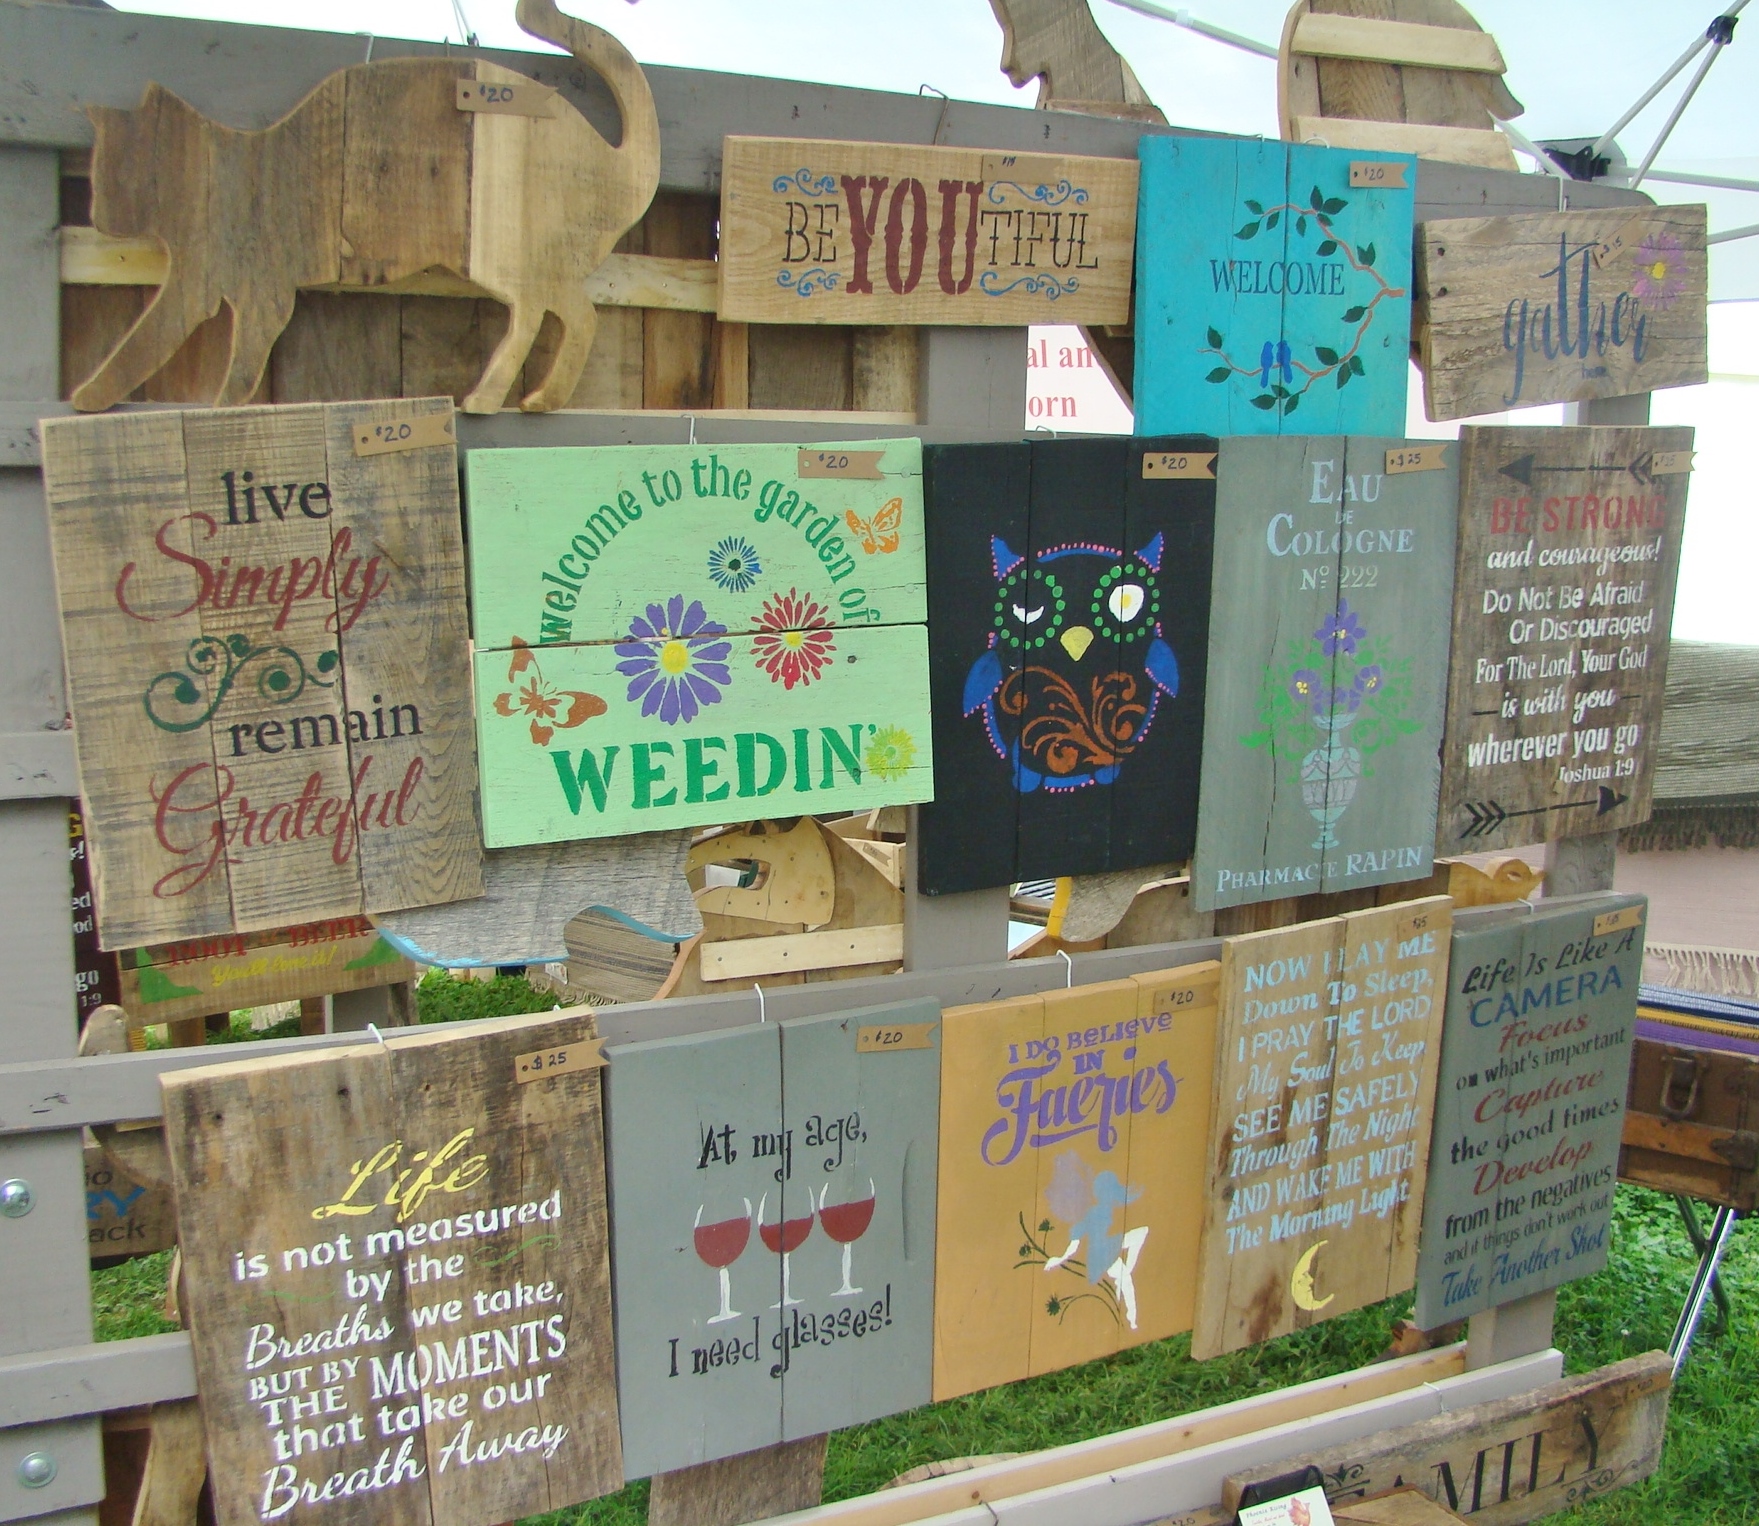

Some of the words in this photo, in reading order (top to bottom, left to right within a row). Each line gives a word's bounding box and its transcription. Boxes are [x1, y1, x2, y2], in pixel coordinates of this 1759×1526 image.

[1210, 259, 1345, 296] WELCOME
[375, 423, 412, 443] $20
[818, 453, 848, 469] $20
[1161, 456, 1187, 470] $20
[220, 470, 333, 526] live
[1490, 497, 1533, 534] BE
[1542, 493, 1667, 532] STRONG
[115, 511, 390, 634] Simply
[540, 486, 644, 644] welcome
[641, 467, 682, 508] to
[690, 454, 752, 501] the
[753, 479, 857, 585] garden
[838, 587, 881, 623] of
[1338, 565, 1379, 589] 222
[1487, 539, 1534, 569] and
[1538, 535, 1662, 577] courageous!
[1482, 589, 1511, 614] Do
[1517, 583, 1552, 613] Not
[1558, 585, 1584, 609] Be
[1589, 580, 1645, 607] Afraid
[1509, 618, 1533, 644] Or
[1539, 608, 1653, 642] Discouraged
[1475, 658, 1503, 684] For
[1507, 655, 1536, 681] The
[1539, 649, 1577, 679] Lord,
[1581, 649, 1616, 674] Your
[1619, 644, 1648, 671] God
[227, 693, 424, 757] remain
[1501, 691, 1519, 719] is
[1524, 683, 1567, 716] with
[1573, 688, 1617, 724] you
[550, 723, 877, 816] WEEDIN'
[1468, 732, 1568, 768] wherever
[1571, 727, 1610, 759] you
[1614, 723, 1640, 755] go
[1558, 765, 1610, 784] Joshua
[1614, 757, 1634, 777] 1:9
[149, 754, 424, 899] Grateful
[1344, 846, 1424, 877] RAPIN
[1244, 954, 1312, 993] NOW
[1323, 951, 1331, 975] I
[1336, 938, 1389, 972] LAY
[1397, 930, 1438, 959] ME
[1462, 958, 1515, 994] Life
[1525, 952, 1547, 976] Is
[1555, 937, 1608, 970] Like
[1615, 927, 1635, 954] A
[1171, 990, 1194, 1005] $20
[1242, 991, 1319, 1025] Down
[1327, 980, 1356, 1006] To
[1364, 967, 1434, 997] Sleep,
[1469, 964, 1622, 1028] CAMERA
[875, 1030, 903, 1044] $20
[1008, 1044, 1019, 1064] I
[1026, 1036, 1060, 1060] DO
[1238, 1037, 1246, 1062] I
[1252, 1020, 1316, 1058] PRAY
[1324, 1008, 1364, 1041] THE
[1371, 995, 1431, 1030] LORD
[1456, 1073, 1478, 1091] on
[1485, 1050, 1539, 1083] what's
[1543, 1027, 1625, 1066] important
[1499, 1014, 1589, 1053] Focus
[1073, 1050, 1105, 1075] IN
[1236, 1062, 1280, 1101] My
[1287, 1046, 1336, 1087] Soul
[1340, 1040, 1364, 1075] To
[1371, 1030, 1426, 1066] Keep
[981, 1047, 1184, 1166] Faeries
[1232, 1104, 1282, 1142] SEE
[1288, 1092, 1329, 1128] ME
[1335, 1069, 1423, 1116] SAFELY
[1474, 1070, 1605, 1123] Capture
[752, 1130, 793, 1182] my
[806, 1111, 867, 1172] age,
[1230, 1127, 1319, 1178] Through
[1325, 1121, 1361, 1151] The
[1363, 1102, 1420, 1142] Night
[1450, 1136, 1488, 1165] the
[1497, 1108, 1554, 1152] good
[1564, 1097, 1619, 1129] times
[311, 1127, 490, 1223] Life
[1227, 1182, 1271, 1222] AND
[1276, 1164, 1331, 1206] WAKE
[1335, 1155, 1364, 1189] ME
[1368, 1140, 1417, 1179] WITH
[1473, 1136, 1593, 1196] Develop
[1226, 1222, 1263, 1255] The
[1269, 1198, 1354, 1242] Morning
[1444, 1245, 1468, 1265] and
[1483, 1225, 1520, 1249] things
[1524, 1211, 1553, 1236] don't
[1557, 1202, 1586, 1225] work
[1590, 1194, 1609, 1212] out
[1445, 1207, 1489, 1239] from
[1496, 1193, 1526, 1221] the
[1531, 1165, 1612, 1209] negatives
[235, 1251, 270, 1281] is
[284, 1233, 353, 1272] not
[367, 1189, 563, 1257] measured
[1441, 1263, 1483, 1307] Take
[1490, 1237, 1560, 1286] Another
[1565, 1223, 1605, 1260] Shot
[346, 1268, 393, 1302] by
[407, 1253, 465, 1285] the
[246, 1303, 395, 1370] Breaths
[410, 1298, 462, 1329] we
[475, 1280, 563, 1317] take,
[669, 1338, 679, 1378] I
[692, 1316, 760, 1375] need
[770, 1283, 893, 1379] glasses!
[250, 1366, 313, 1400] BUT
[322, 1355, 362, 1384] BY
[260, 1385, 348, 1426] THE
[370, 1314, 566, 1400] MOMENTS
[273, 1412, 366, 1461] that
[378, 1393, 469, 1435] take
[483, 1372, 552, 1411] our
[261, 1435, 428, 1520] Breath
[438, 1419, 570, 1473] Away
